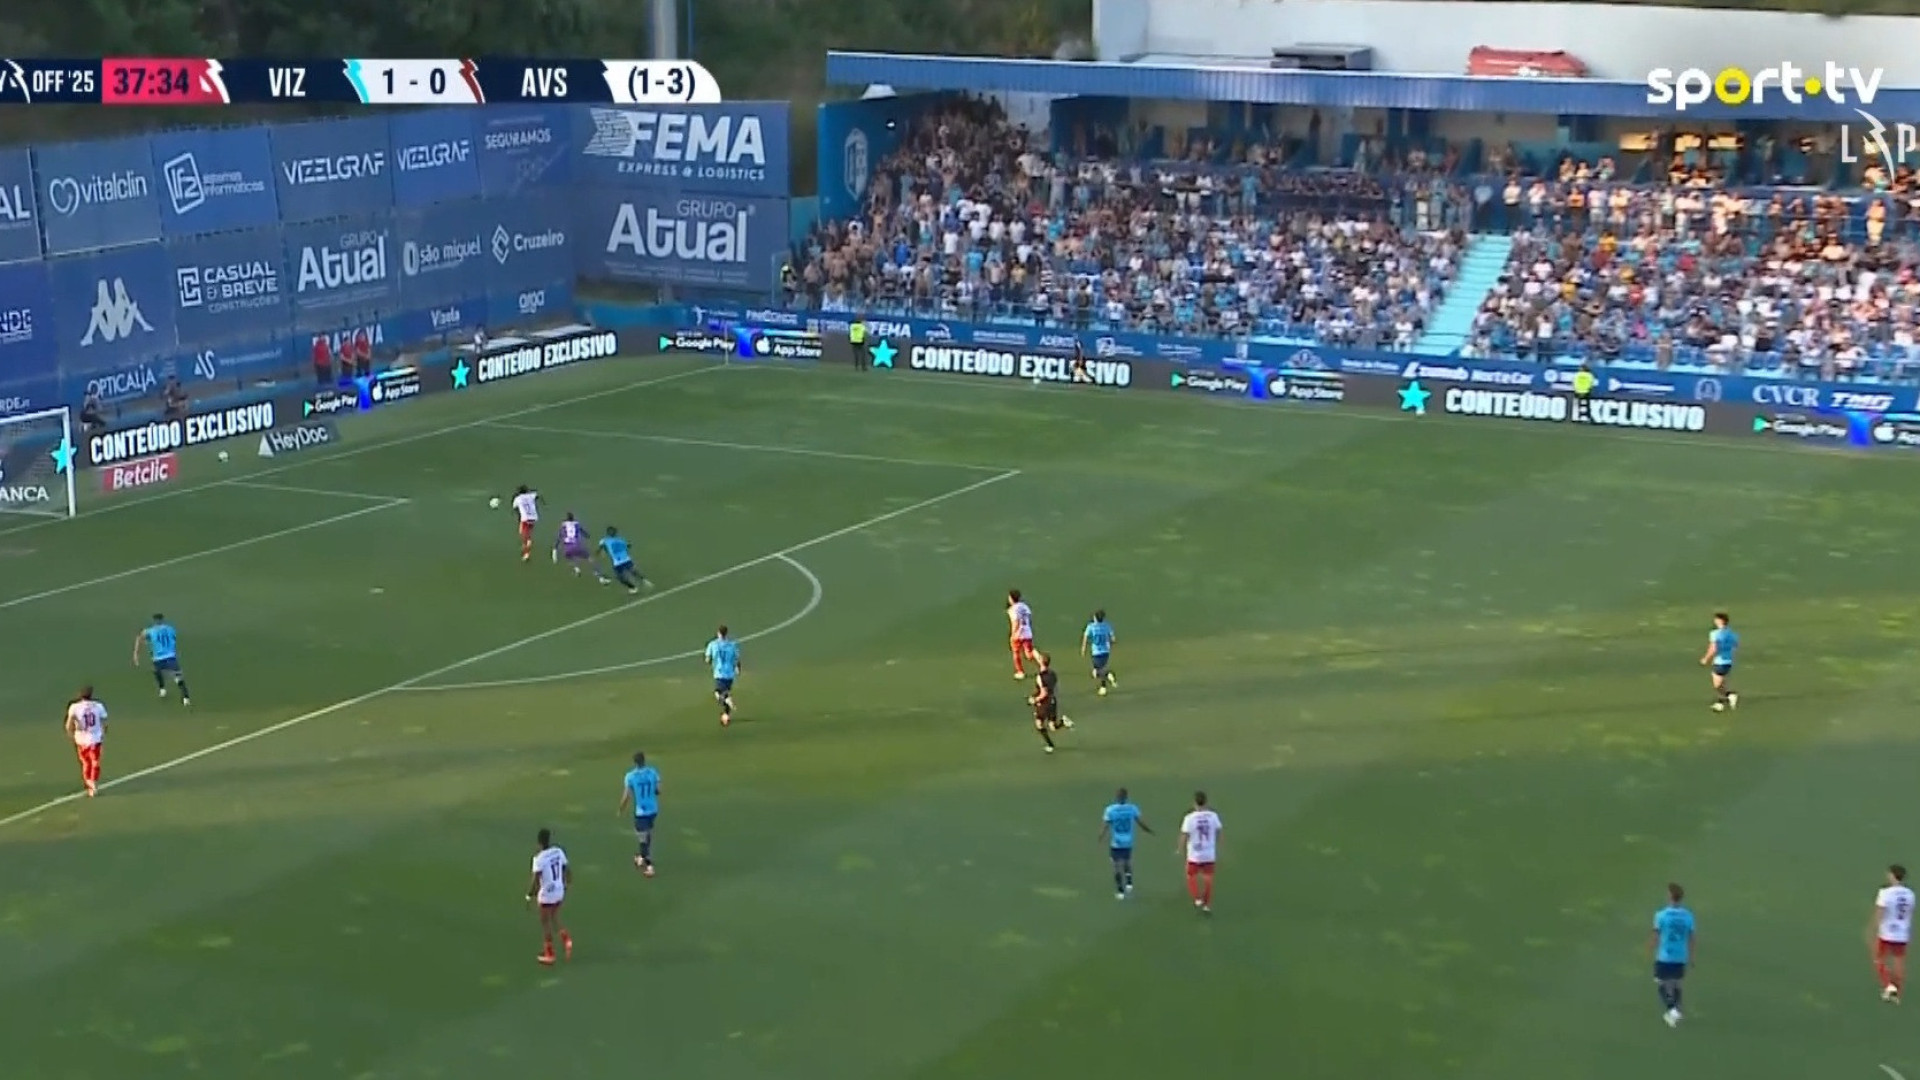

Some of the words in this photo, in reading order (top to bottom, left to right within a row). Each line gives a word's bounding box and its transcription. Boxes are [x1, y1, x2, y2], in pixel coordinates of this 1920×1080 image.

[484, 128, 552, 149] SEGURAMOS
[622, 111, 766, 164] FEMA
[618, 160, 677, 176] EXPRESS
[698, 167, 765, 180] LOGISTICS
[81, 170, 148, 205] vitalclin
[676, 199, 736, 219] GRUPO
[340, 229, 377, 248] GRUPO
[513, 228, 565, 251] Cruzeiro
[606, 203, 748, 262] Atual
[443, 233, 482, 262] miguel
[204, 261, 276, 283] CASUAL
[298, 235, 387, 292] Atual
[222, 277, 278, 298] BREVE
[676, 337, 712, 350] Google
[773, 344, 796, 357] App
[796, 345, 822, 357] Store
[478, 349, 541, 383] CONTEÚDO
[543, 333, 617, 368] EXCLUSIVO
[911, 345, 1014, 377] CONTEÚDO
[1187, 376, 1223, 391] Google
[1752, 385, 1820, 407] CVCR
[1445, 387, 1567, 421] CONTEÚDO
[1572, 396, 1705, 431] EXCLUSIVO
[91, 421, 181, 464] CONTEÚDO
[186, 402, 273, 442] EXCLUSIVO
[271, 425, 328, 451] HeyDoc
[112, 461, 168, 489] Betclic
[84, 711, 95, 727] 10
